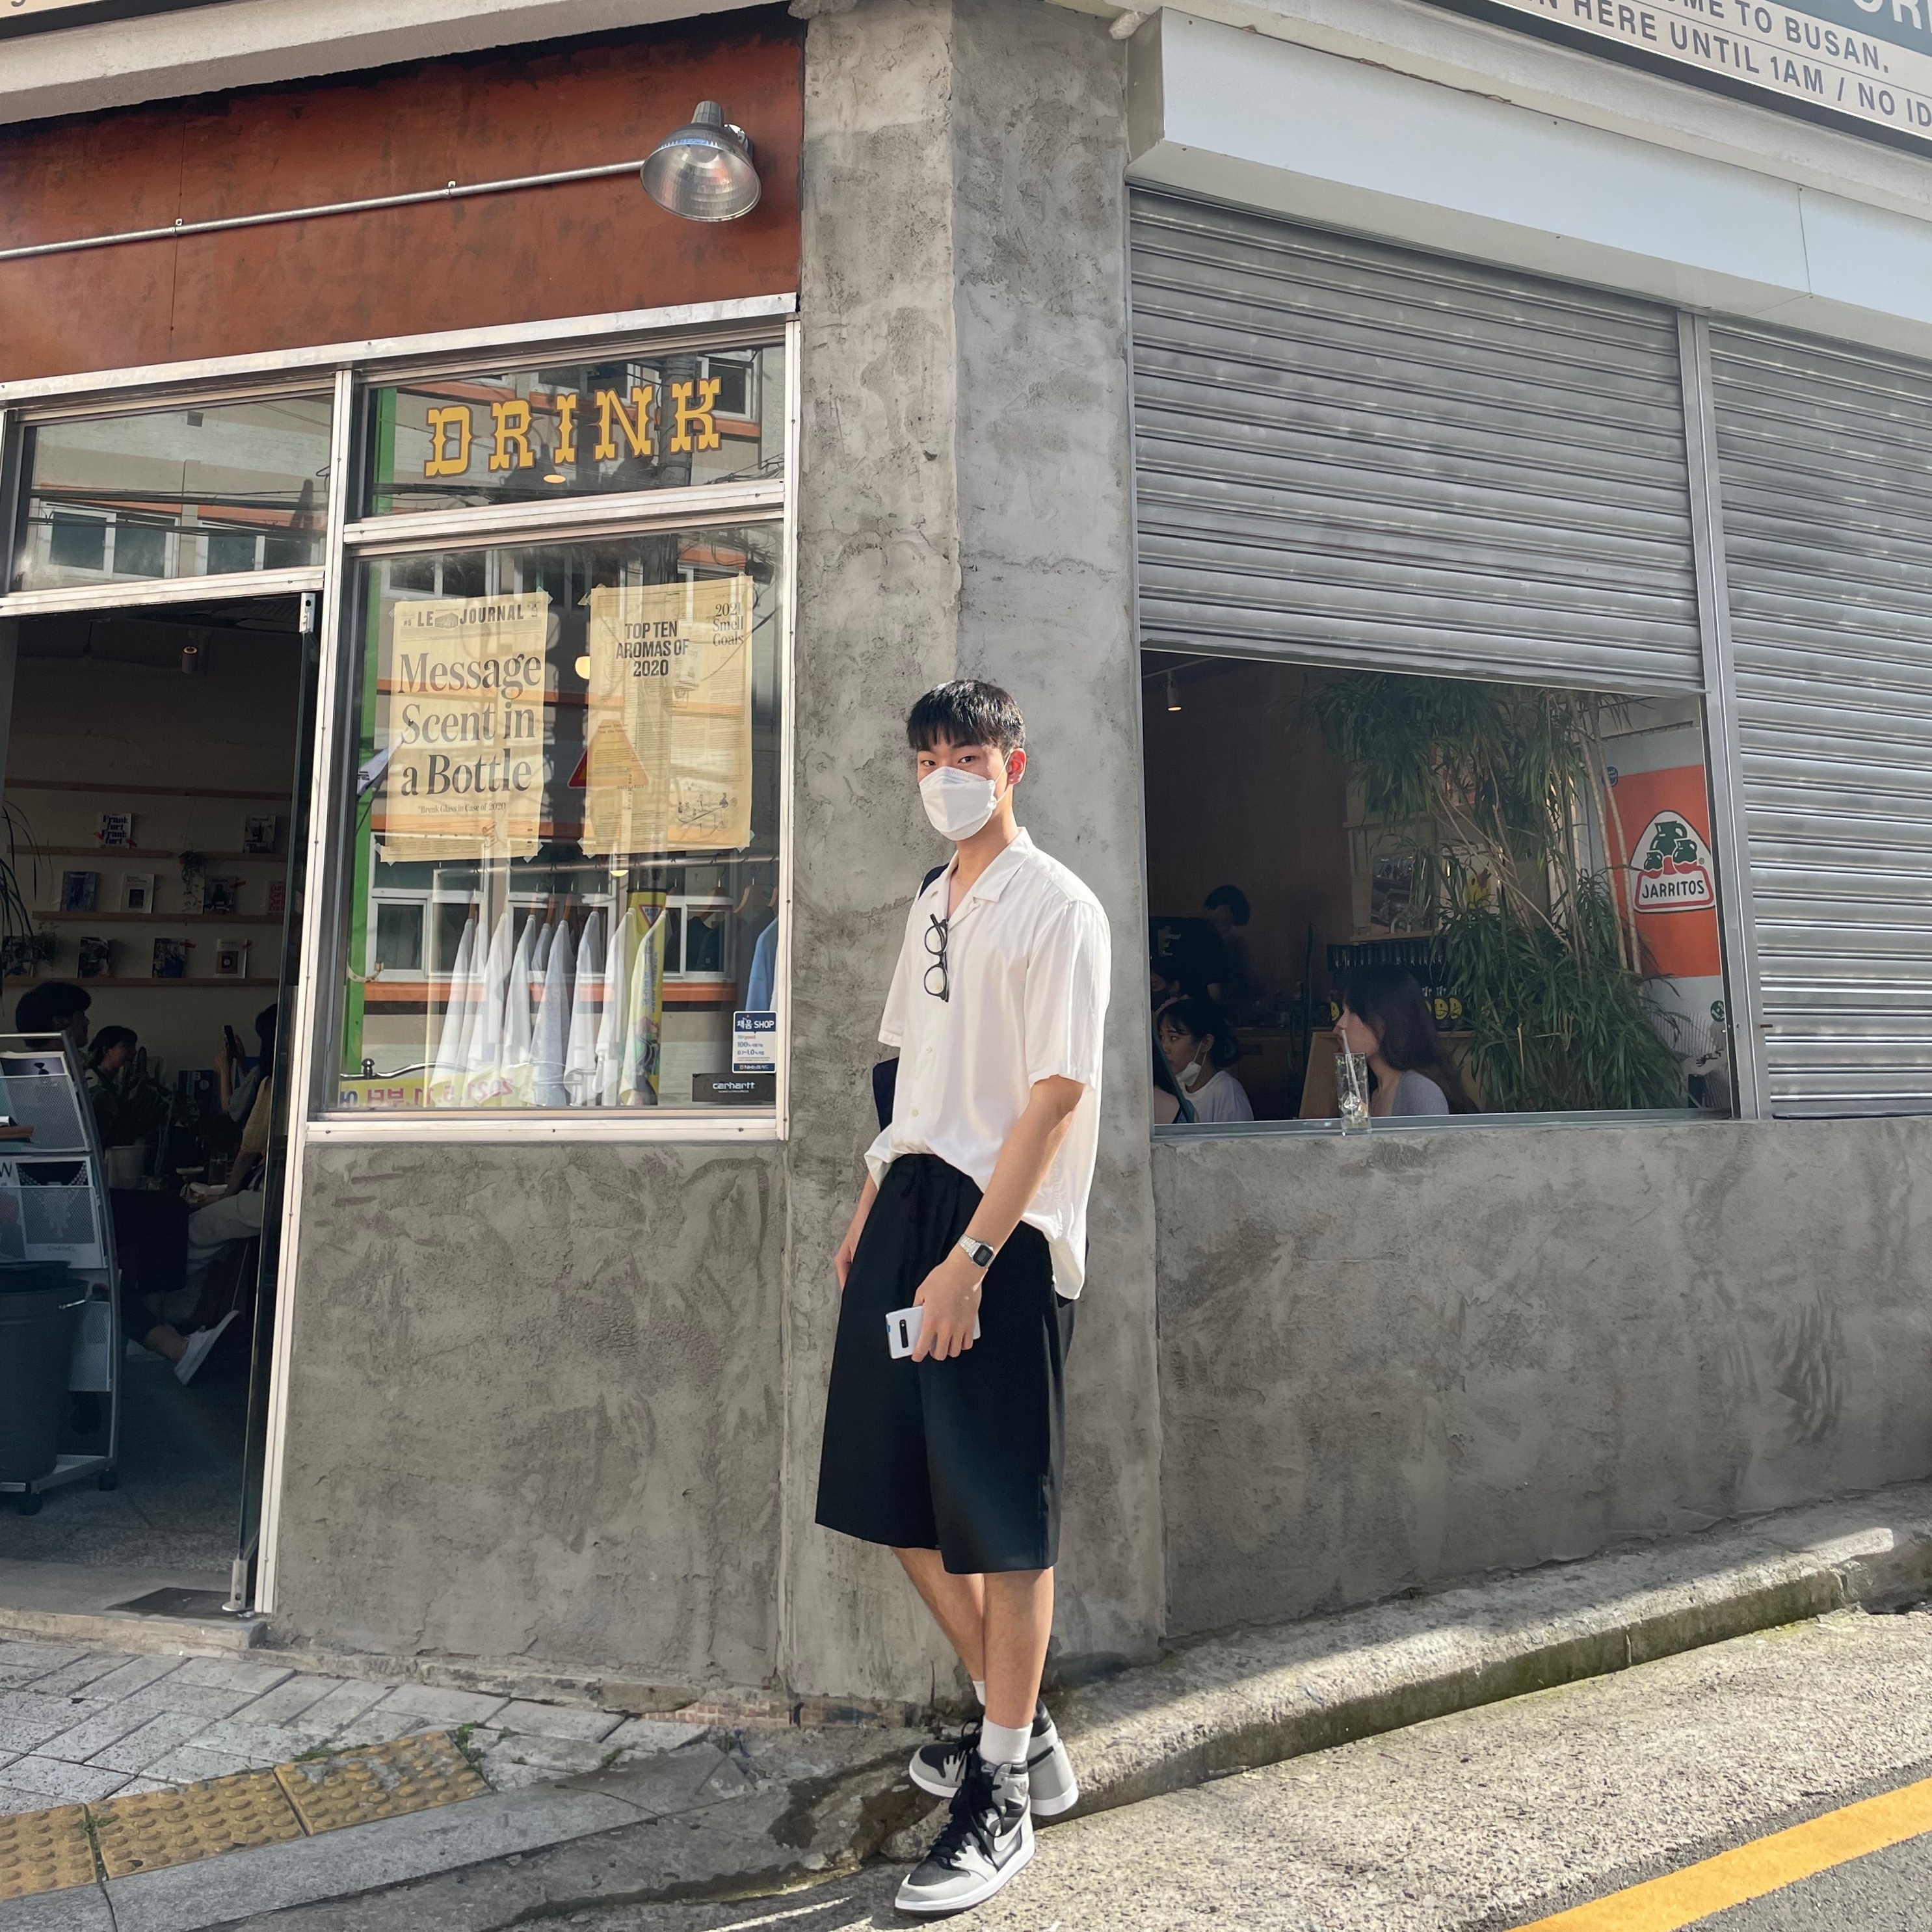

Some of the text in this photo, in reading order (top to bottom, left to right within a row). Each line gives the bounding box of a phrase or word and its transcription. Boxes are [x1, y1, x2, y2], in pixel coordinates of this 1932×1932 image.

[1735, 0, 1773, 33] TO
[1784, 16, 1888, 73] BUSAN.
[1572, 0, 1657, 41] HERE
[1669, 21, 1760, 73] UNTIL
[1770, 56, 1823, 94] 1AM
[1858, 82, 1895, 115] NO
[1907, 98, 1931, 127] ID
[424, 377, 722, 479] DRINK
[417, 611, 434, 627] LE
[460, 604, 523, 625] JOURNAL
[715, 602, 741, 617] 2021
[625, 620, 678, 639] TOP TEN
[713, 616, 744, 632] Smell
[713, 631, 744, 646] Goals
[616, 639, 690, 659] AROMAS OF
[398, 652, 542, 700] Message
[633, 659, 668, 677] 2020
[401, 702, 535, 745] Scent in
[401, 748, 532, 796] a Bottle
[440, 804, 457, 813] Glass
[465, 803, 479, 812] Case
[481, 802, 487, 811] of
[488, 802, 506, 811] 2020
[1642, 879, 1705, 898] JARRITOS
[754, 1020, 774, 1029] SHOP
